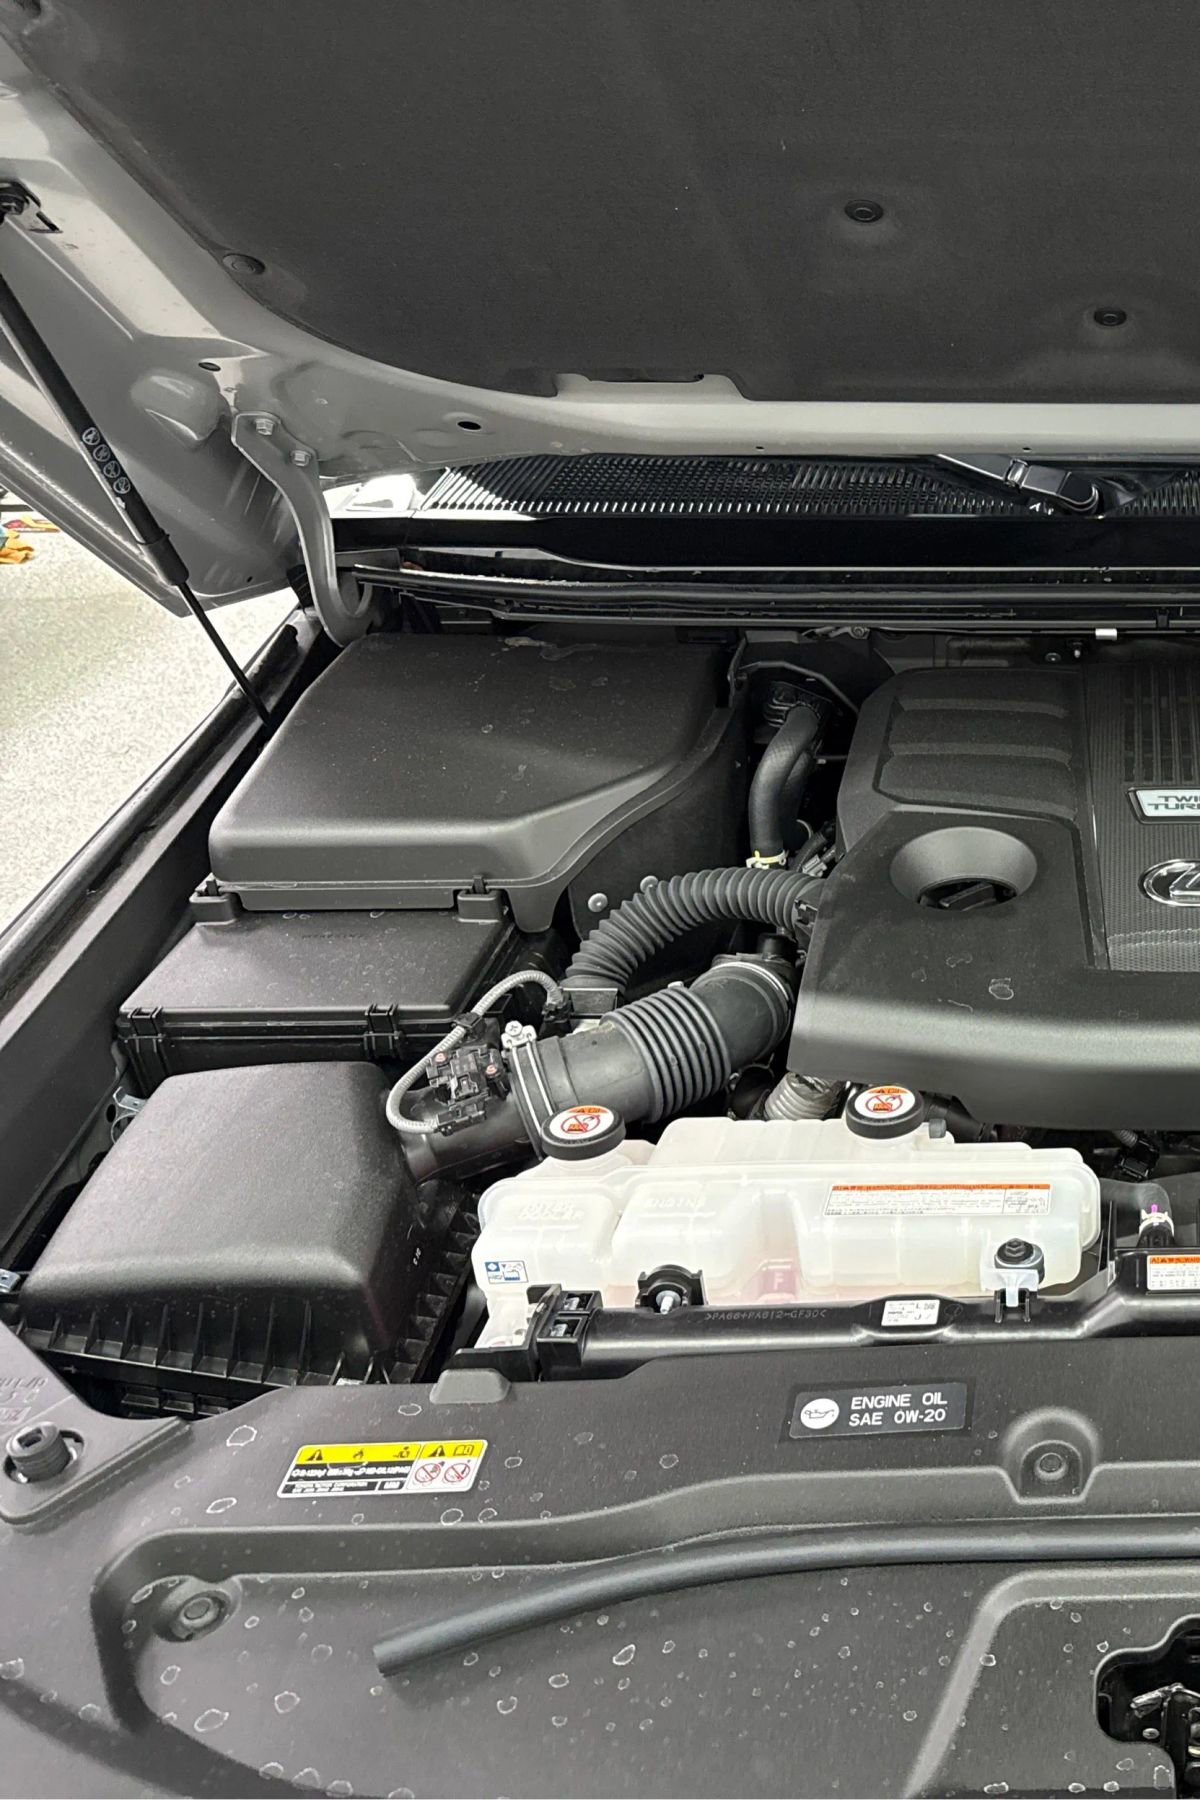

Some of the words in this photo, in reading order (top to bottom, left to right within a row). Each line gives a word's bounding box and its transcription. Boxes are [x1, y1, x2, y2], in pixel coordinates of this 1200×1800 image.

[851, 1394, 911, 1410] ENGINE
[922, 1392, 948, 1405] OIL
[849, 1412, 883, 1427] SAE
[894, 1408, 946, 1424] 0W-20
